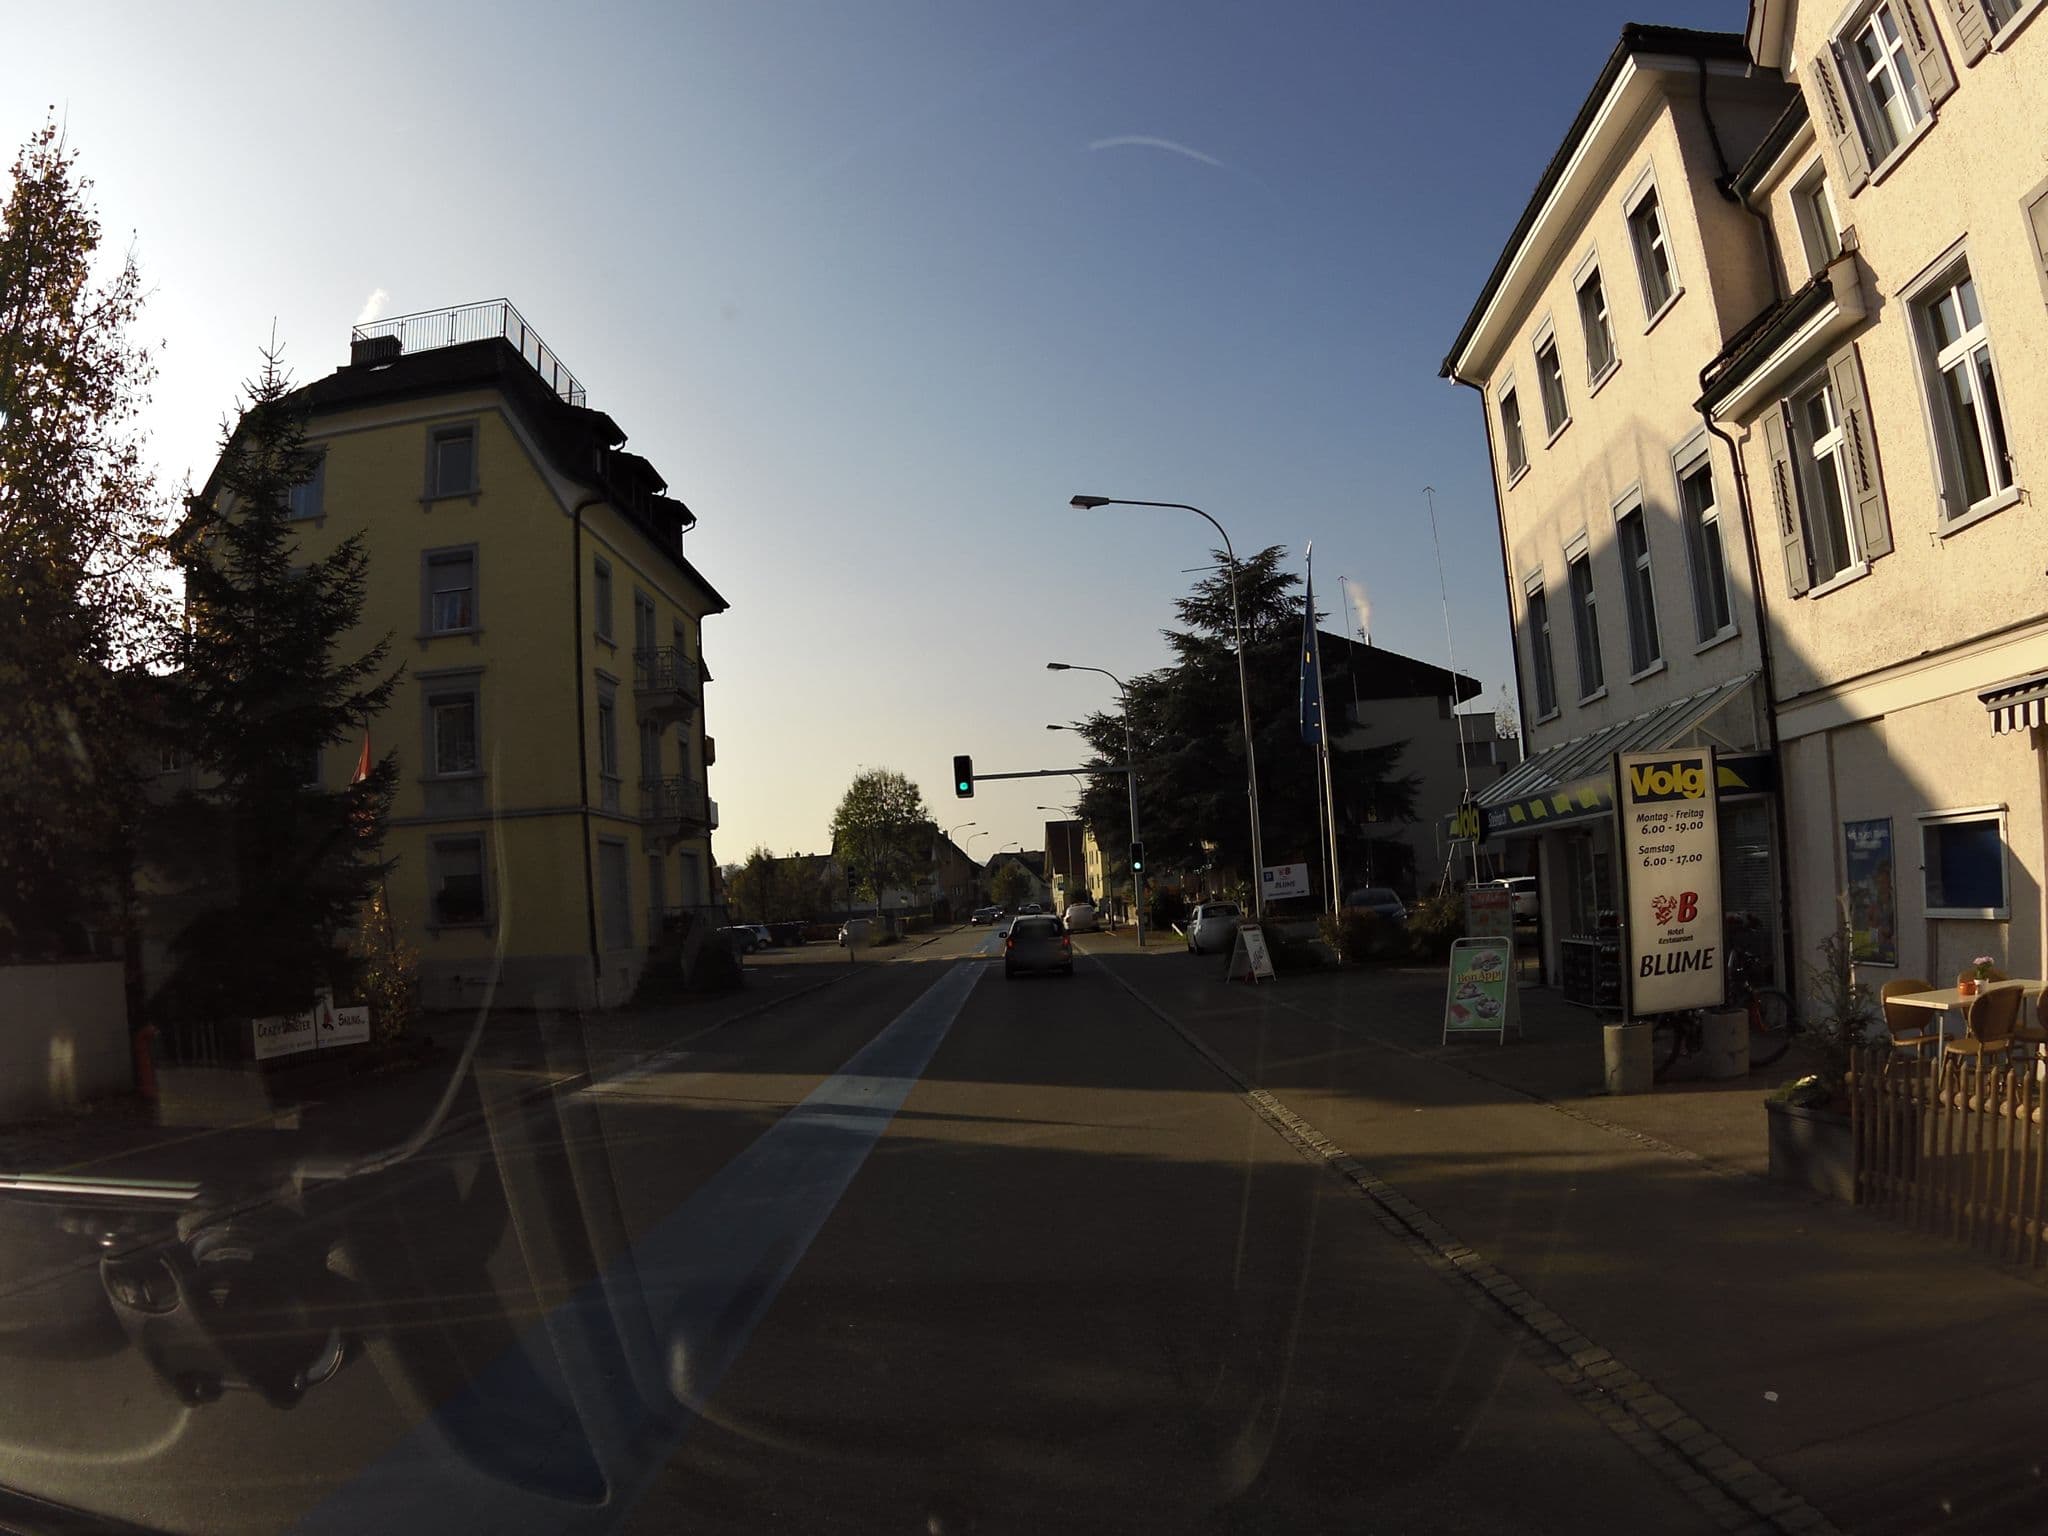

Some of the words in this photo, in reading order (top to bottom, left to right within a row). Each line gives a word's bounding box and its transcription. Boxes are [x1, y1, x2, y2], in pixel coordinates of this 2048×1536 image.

[1630, 763, 1705, 799] Volg
[1636, 813, 1668, 823] Montag
[1676, 809, 1704, 819] Freitag
[1456, 804, 1480, 846] Volg
[1641, 824, 1665, 834] 6.00
[1675, 821, 1703, 833] 19.00
[1638, 844, 1675, 854] Samstag
[1643, 856, 1666, 867] 6.00
[1676, 853, 1702, 866] 17.00
[1678, 892, 1698, 923] B
[1667, 928, 1684, 936] Hotel
[1658, 935, 1693, 944] Restaurant
[1640, 948, 1715, 978] BLUME
